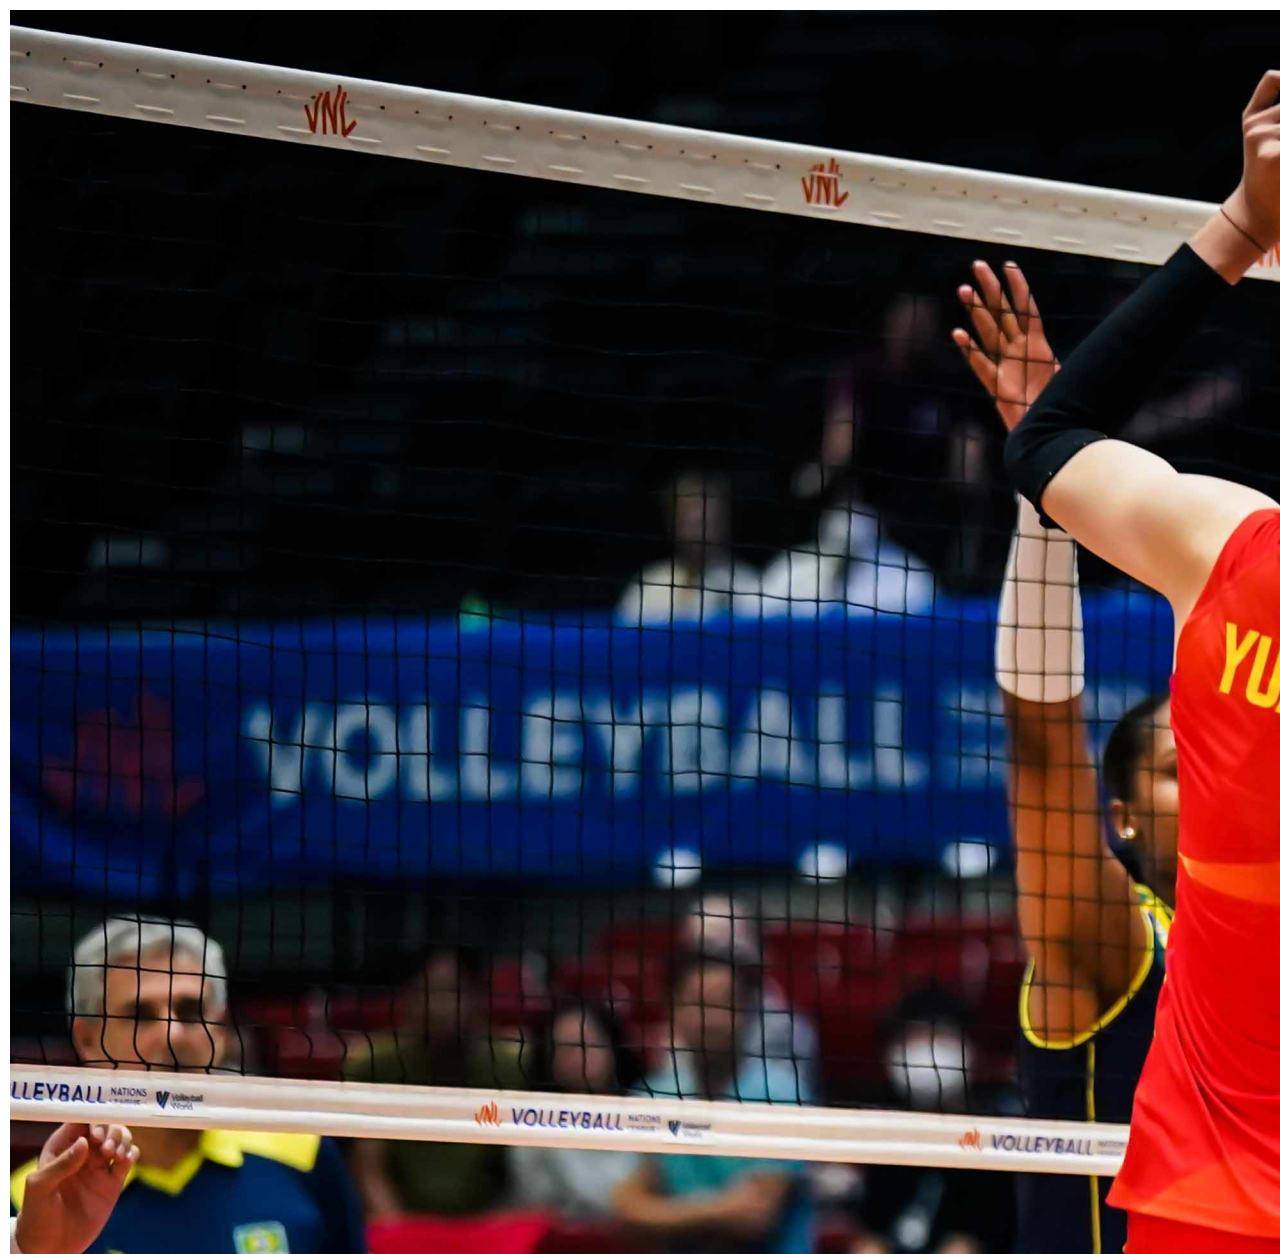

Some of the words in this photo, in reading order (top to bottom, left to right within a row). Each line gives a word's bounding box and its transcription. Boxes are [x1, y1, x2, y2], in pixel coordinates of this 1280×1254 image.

[304, 84, 357, 138] VNL
[801, 157, 849, 207] VNL
[243, 688, 927, 802] VOLLEYBALL
[110, 1087, 147, 1097] NATIONS
[512, 1108, 624, 1132] VOLLEYBALL
[991, 1134, 1095, 1157] VOLLEYBALL
